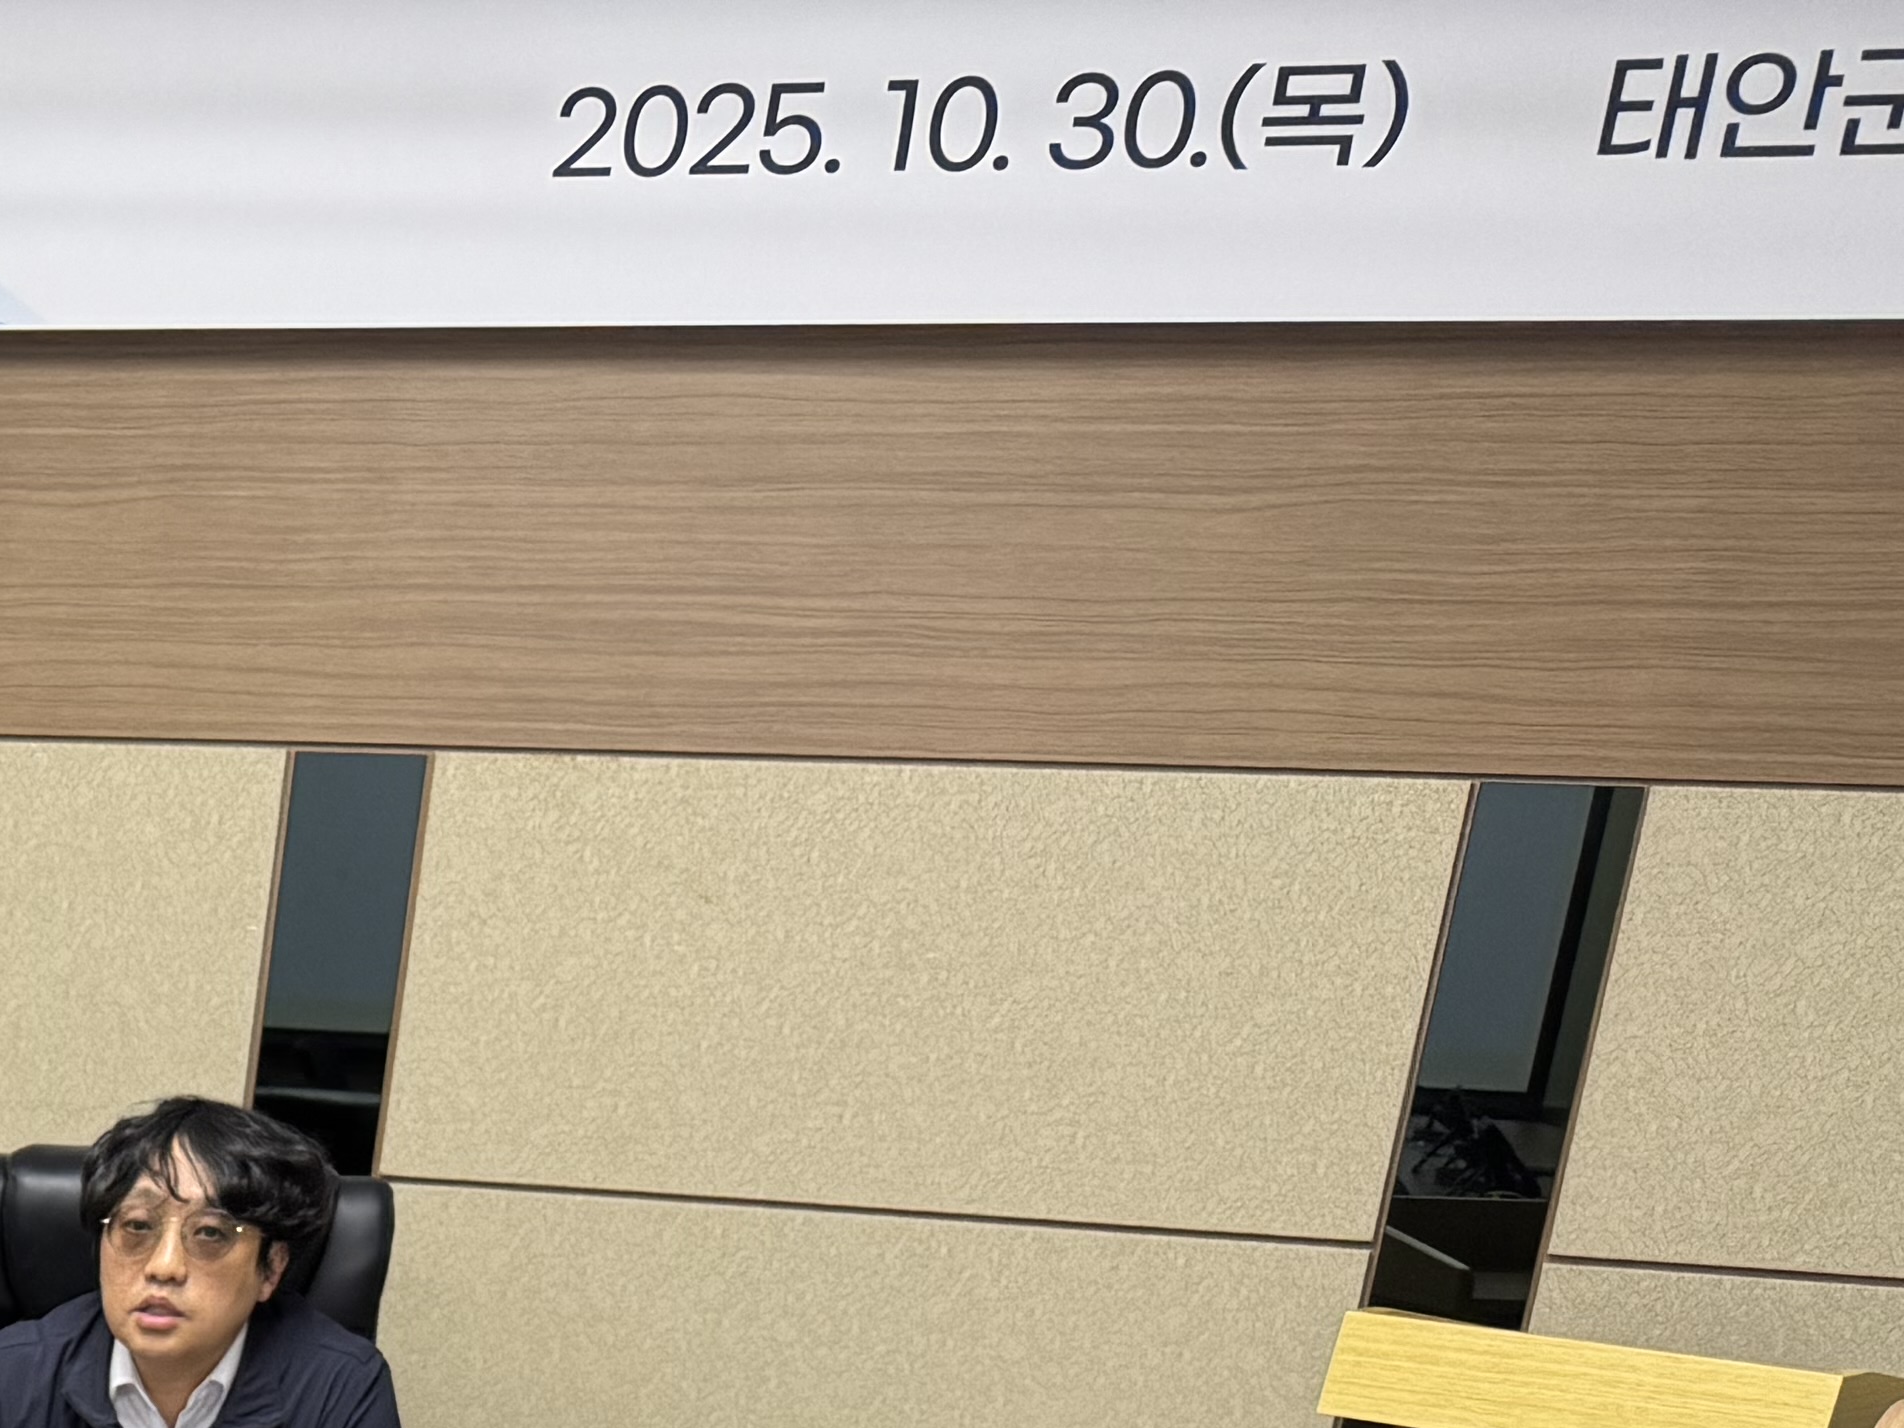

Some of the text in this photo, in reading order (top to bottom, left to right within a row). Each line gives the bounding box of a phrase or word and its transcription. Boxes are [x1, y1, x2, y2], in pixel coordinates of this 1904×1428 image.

[552, 81, 840, 178] 2025.
[886, 75, 1009, 171] 10.
[1048, 59, 1408, 171] 30.(목)
